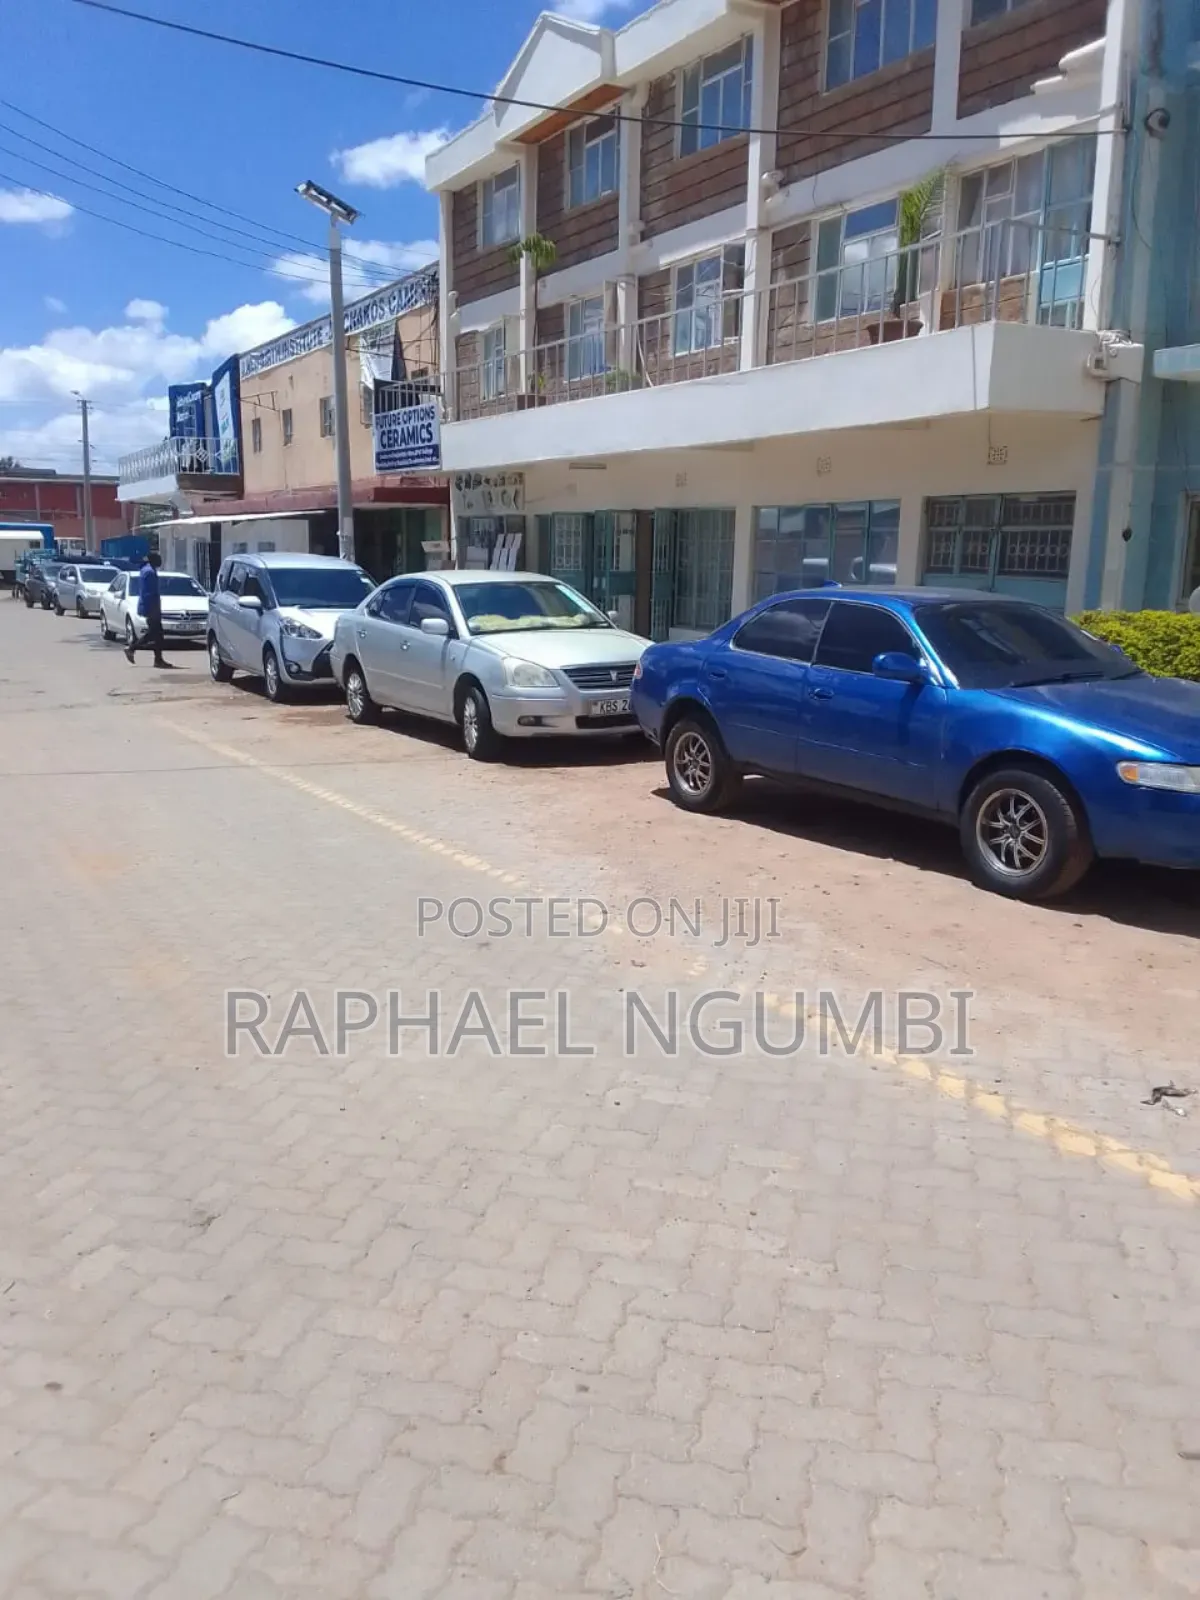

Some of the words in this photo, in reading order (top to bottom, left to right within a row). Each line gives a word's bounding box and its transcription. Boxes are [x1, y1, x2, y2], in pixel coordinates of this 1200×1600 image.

[402, 405, 436, 425] OPTIONS
[380, 422, 434, 449] CERAMICS
[600, 700, 618, 713] KBS
